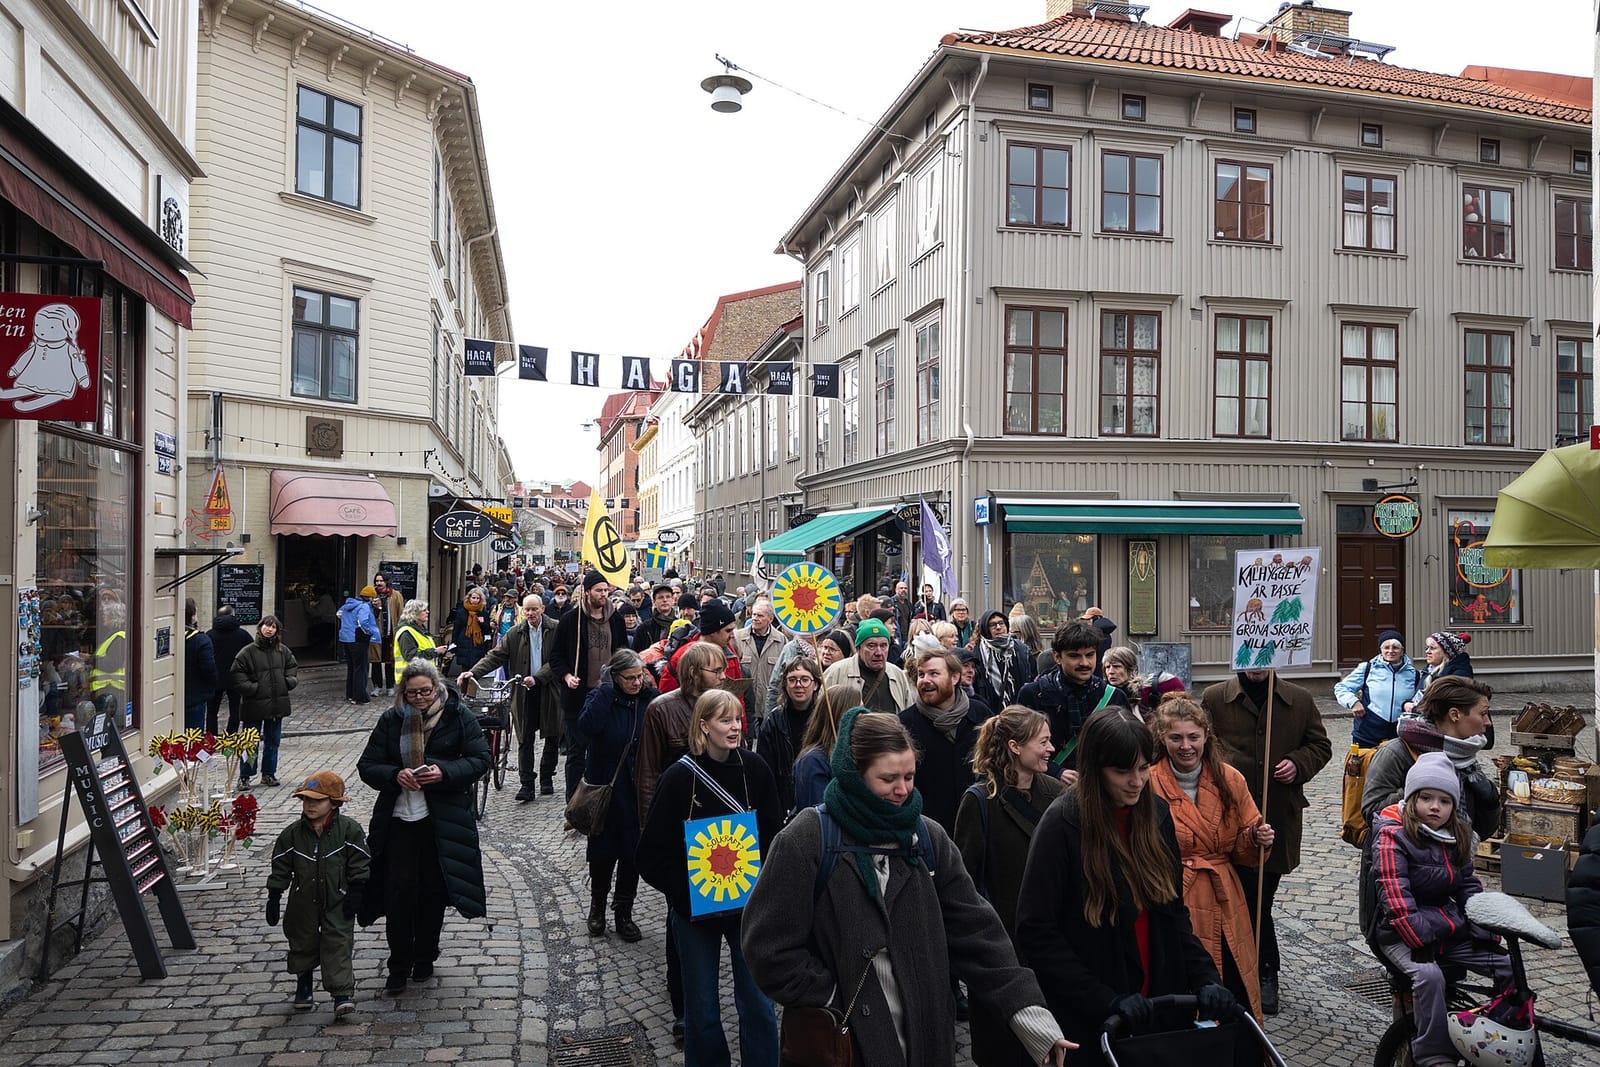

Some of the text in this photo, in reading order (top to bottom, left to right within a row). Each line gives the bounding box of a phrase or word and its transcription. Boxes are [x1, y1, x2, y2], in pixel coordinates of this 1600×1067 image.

[466, 350, 492, 362] HAGA
[770, 371, 792, 381] HAGA
[445, 517, 481, 528] CAFÉ
[1250, 584, 1267, 598] ÄR
[810, 601, 824, 616] TACK
[1236, 620, 1310, 637] GRÖNA SKOGAR
[1244, 638, 1269, 649] VILL
[85, 733, 109, 750] MUSIC
[710, 865, 744, 885] JA TACK
